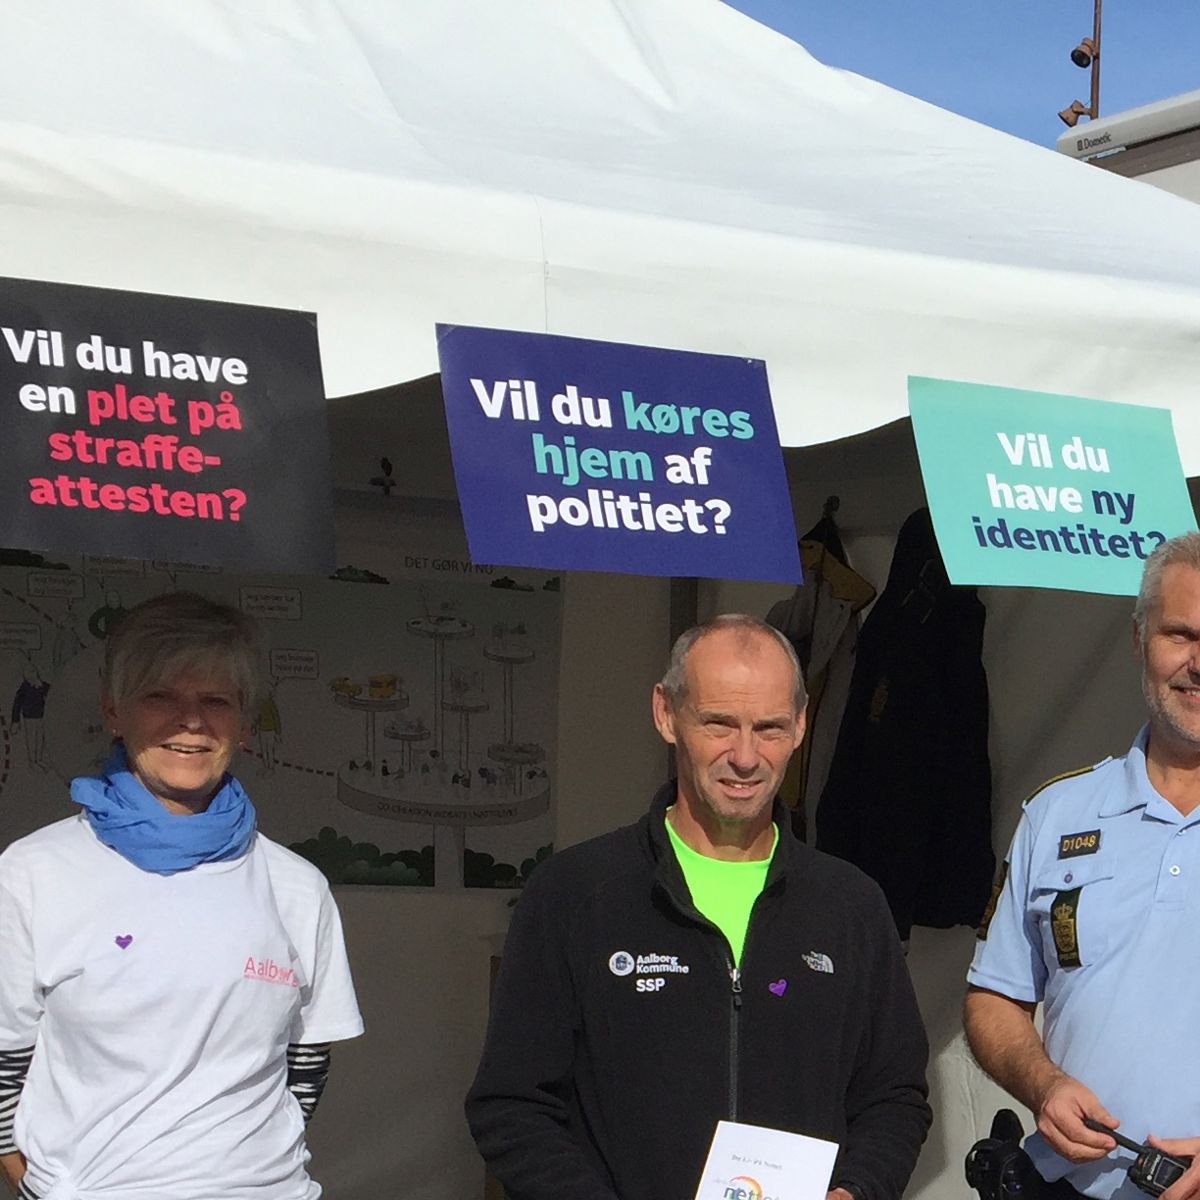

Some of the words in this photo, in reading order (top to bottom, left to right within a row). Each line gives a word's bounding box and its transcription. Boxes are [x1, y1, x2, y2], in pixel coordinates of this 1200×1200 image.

[1, 327, 64, 367] Vil
[76, 335, 132, 375] du
[143, 341, 248, 385] have
[19, 384, 76, 414] en
[87, 384, 177, 425] plet
[188, 391, 242, 435] på
[470, 378, 540, 421] Vil
[552, 385, 613, 428] du
[621, 391, 754, 439] køres
[49, 430, 221, 473] straffe-
[532, 433, 653, 486] hjem
[664, 447, 713, 485] af
[997, 433, 1053, 468] Vil
[1061, 437, 1110, 473] du
[29, 475, 247, 521] attesten?
[526, 489, 731, 534] politiet?
[986, 473, 1083, 513] have
[1092, 490, 1135, 524] ny
[636, 963, 689, 974] Kommune
[637, 953, 679, 966] Aalborg
[636, 978, 665, 992] SSP
